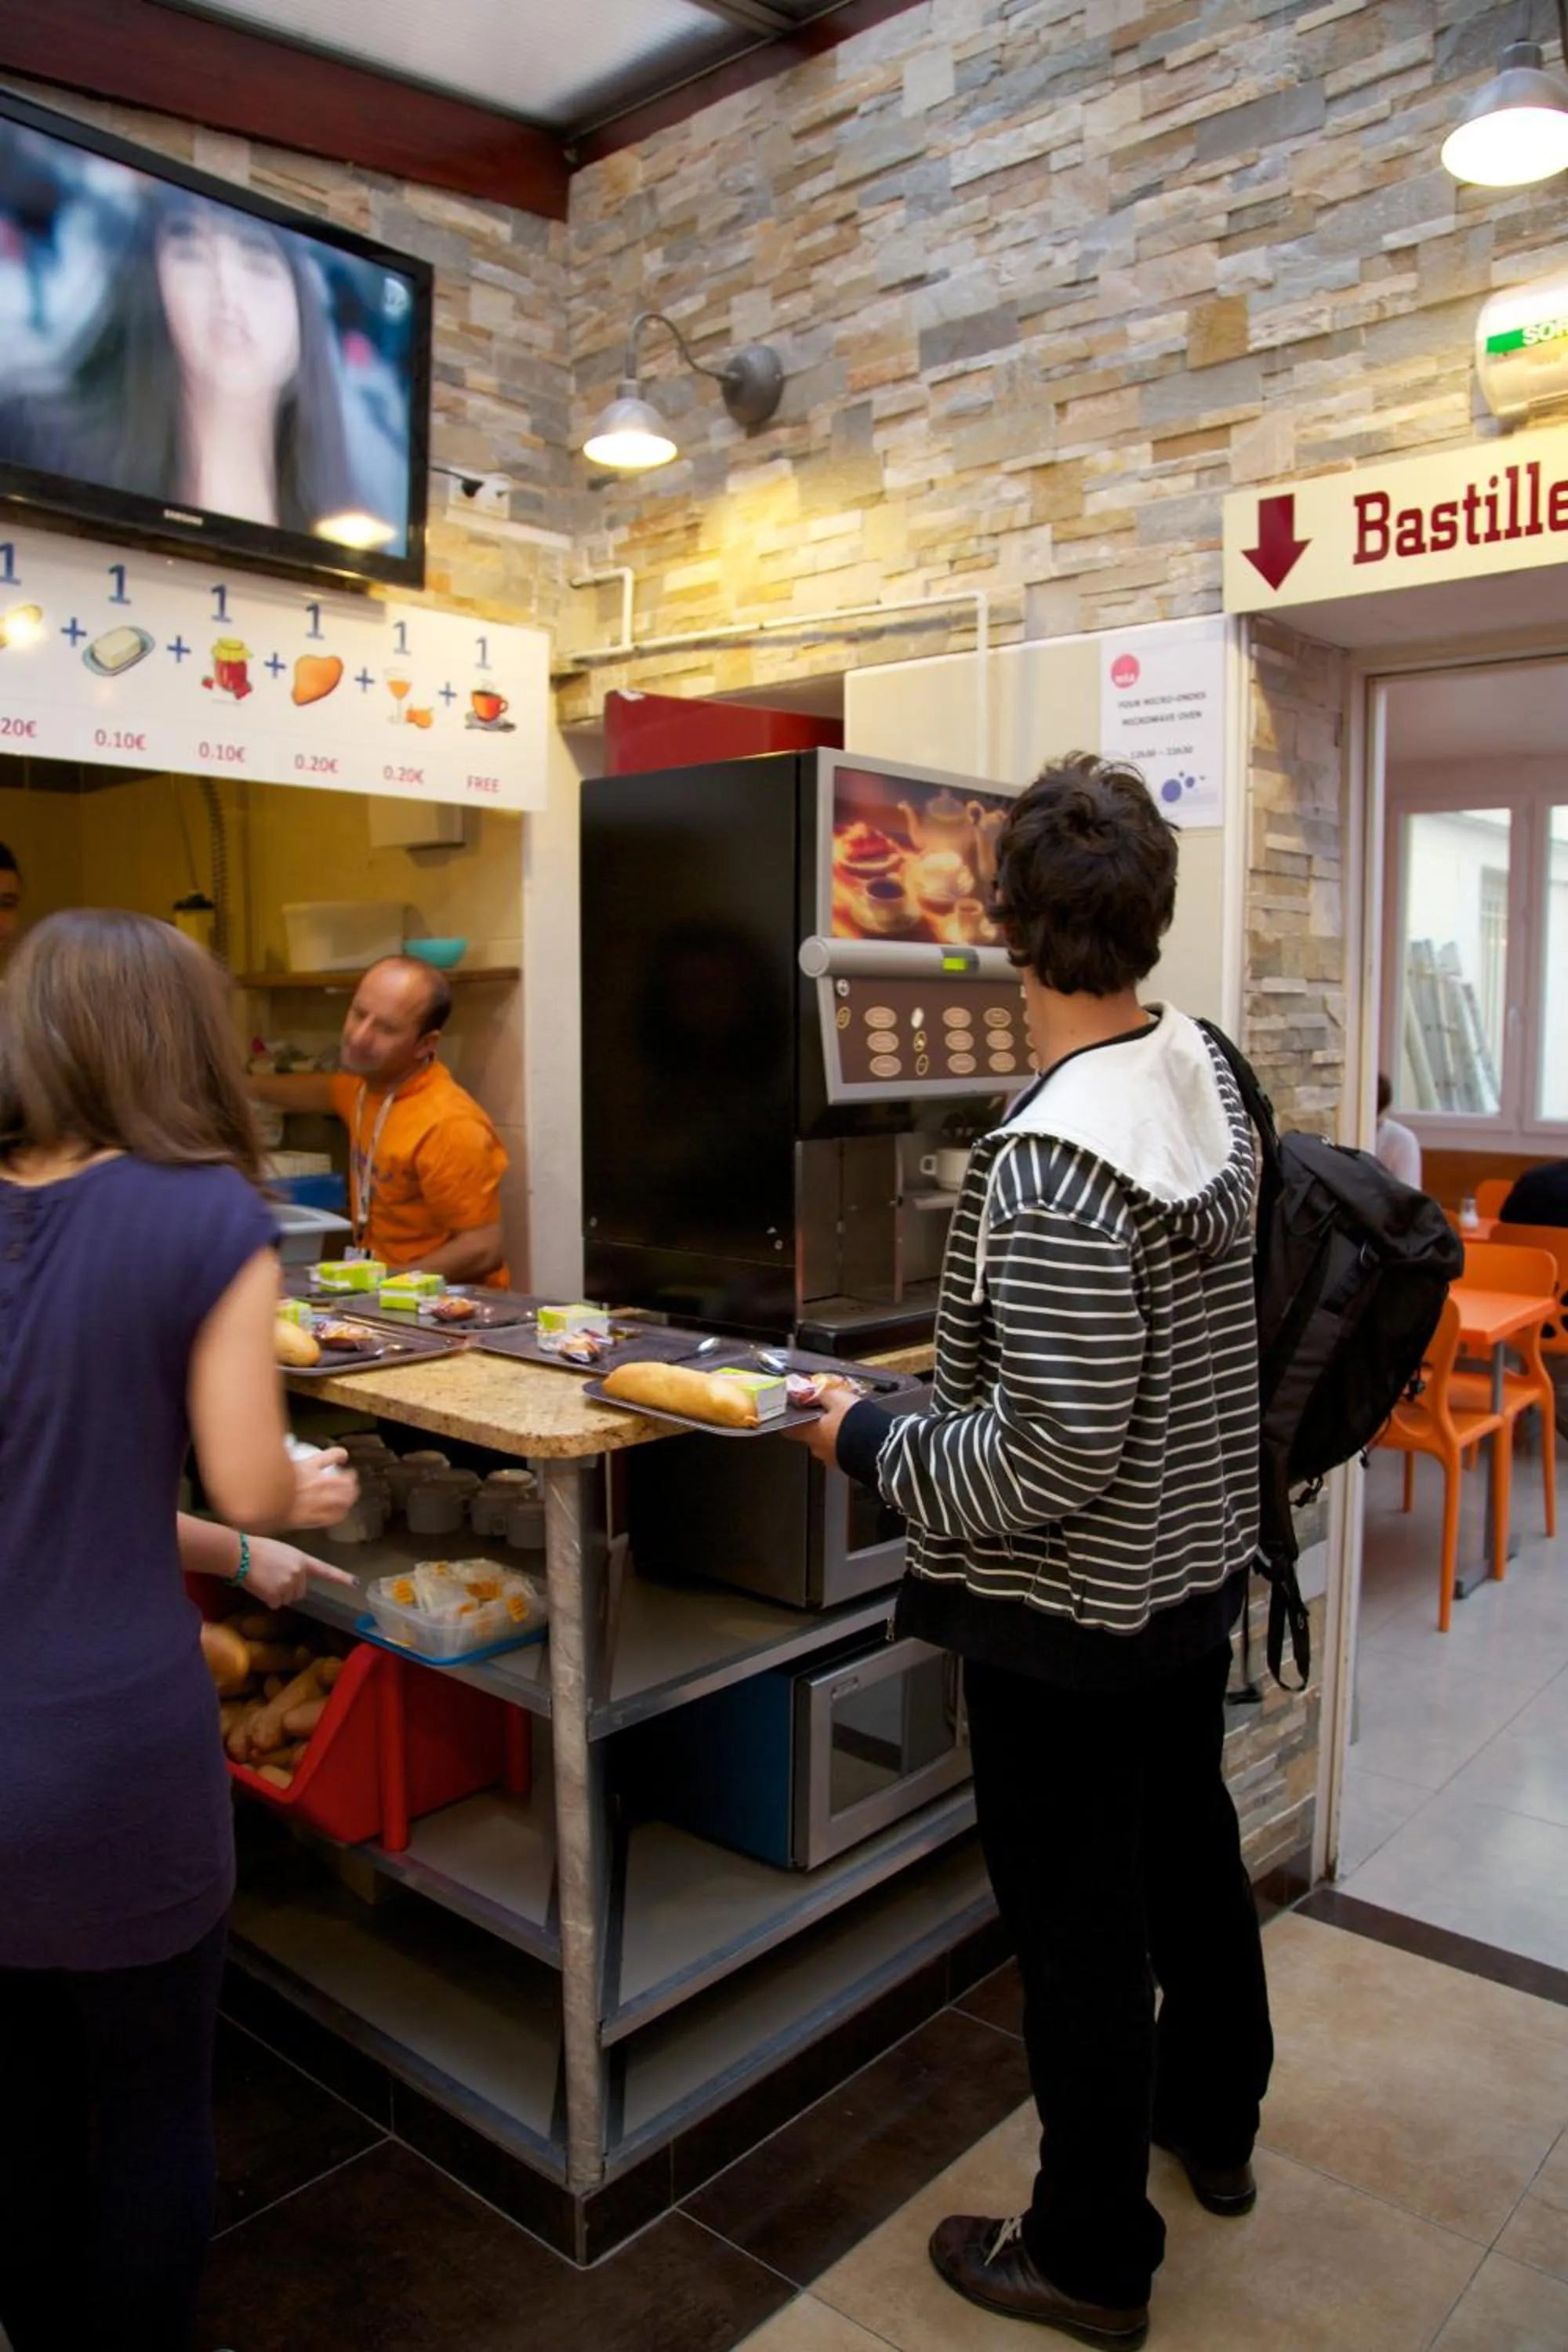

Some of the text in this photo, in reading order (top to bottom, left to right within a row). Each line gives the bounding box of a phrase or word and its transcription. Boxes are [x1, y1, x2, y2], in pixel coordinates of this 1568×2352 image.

[1352, 460, 1568, 565] Bastille
[107, 563, 132, 606] 1
[210, 584, 233, 623] 1
[304, 601, 325, 641] 1
[393, 619, 412, 656] 1
[474, 635, 493, 670] 1
[93, 728, 147, 751] 0.10€
[198, 741, 246, 764] 0.10€
[293, 753, 339, 775] 0.20€
[383, 764, 425, 786] 0.20€
[466, 774, 500, 794] FREE
